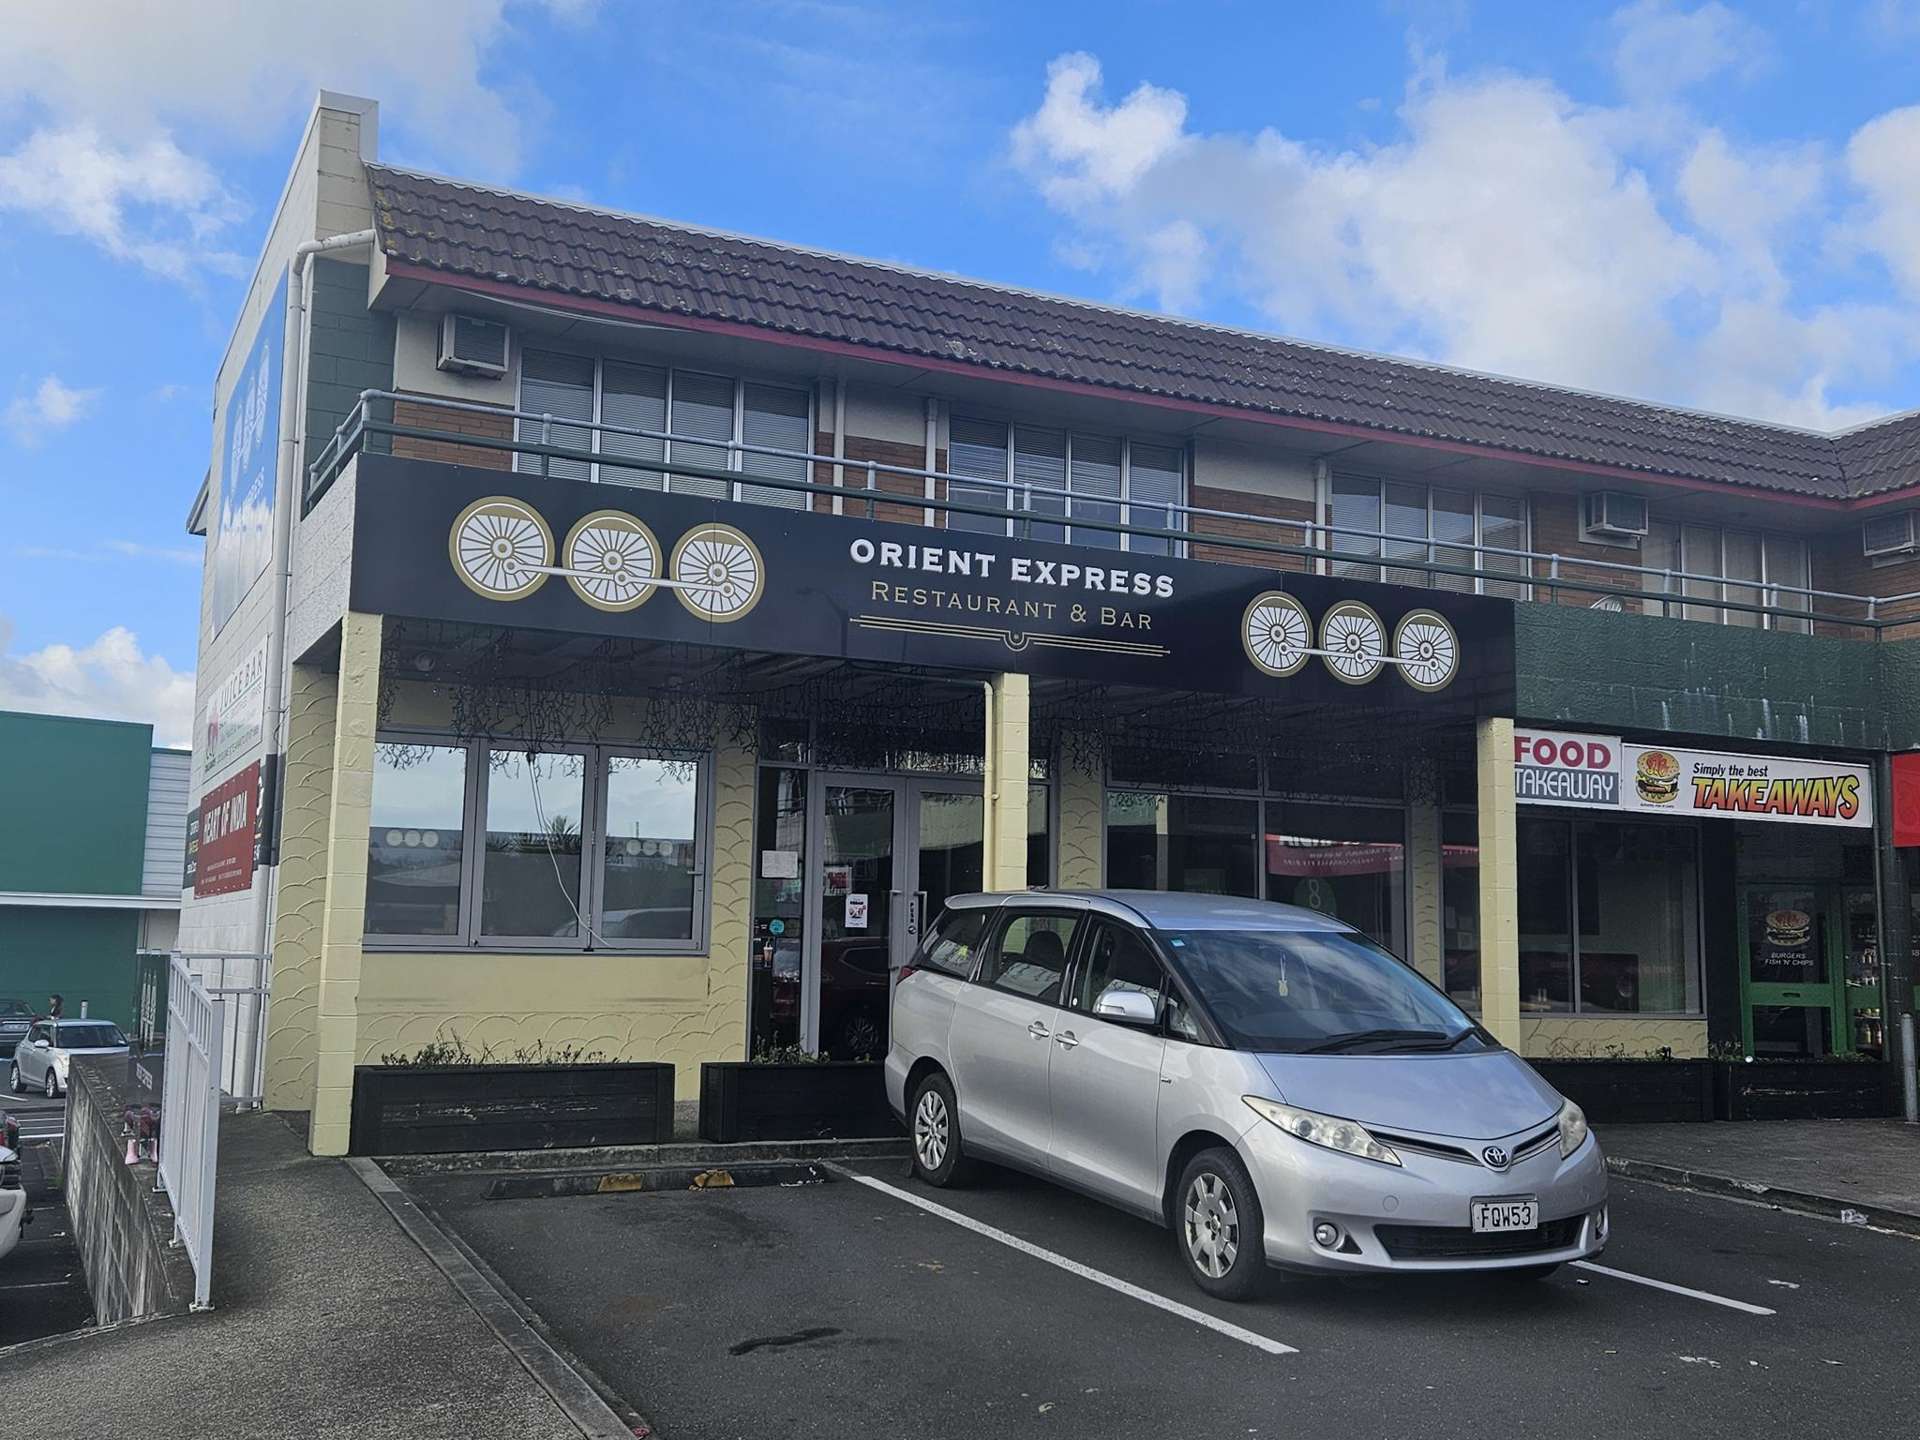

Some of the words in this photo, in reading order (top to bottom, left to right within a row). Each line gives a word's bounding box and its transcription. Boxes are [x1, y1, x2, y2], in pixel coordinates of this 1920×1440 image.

[850, 538, 996, 578] ORIENT
[1011, 557, 1174, 598] EXPRESS
[1070, 603, 1087, 623] &
[219, 671, 243, 713] JUICE
[244, 649, 263, 688] BAR
[1514, 735, 1612, 770] FOOD
[1693, 762, 1727, 777] Simply
[1728, 764, 1745, 777] the
[1747, 765, 1769, 777] best
[1515, 768, 1614, 801] TAKEAWAY
[1691, 774, 1861, 820] TAKEAWAYS
[202, 805, 221, 845] HEART
[221, 800, 231, 837] OF
[229, 790, 248, 833] INDIA
[1771, 951, 1807, 960] BURGERS
[1481, 1205, 1532, 1229] FQW53
